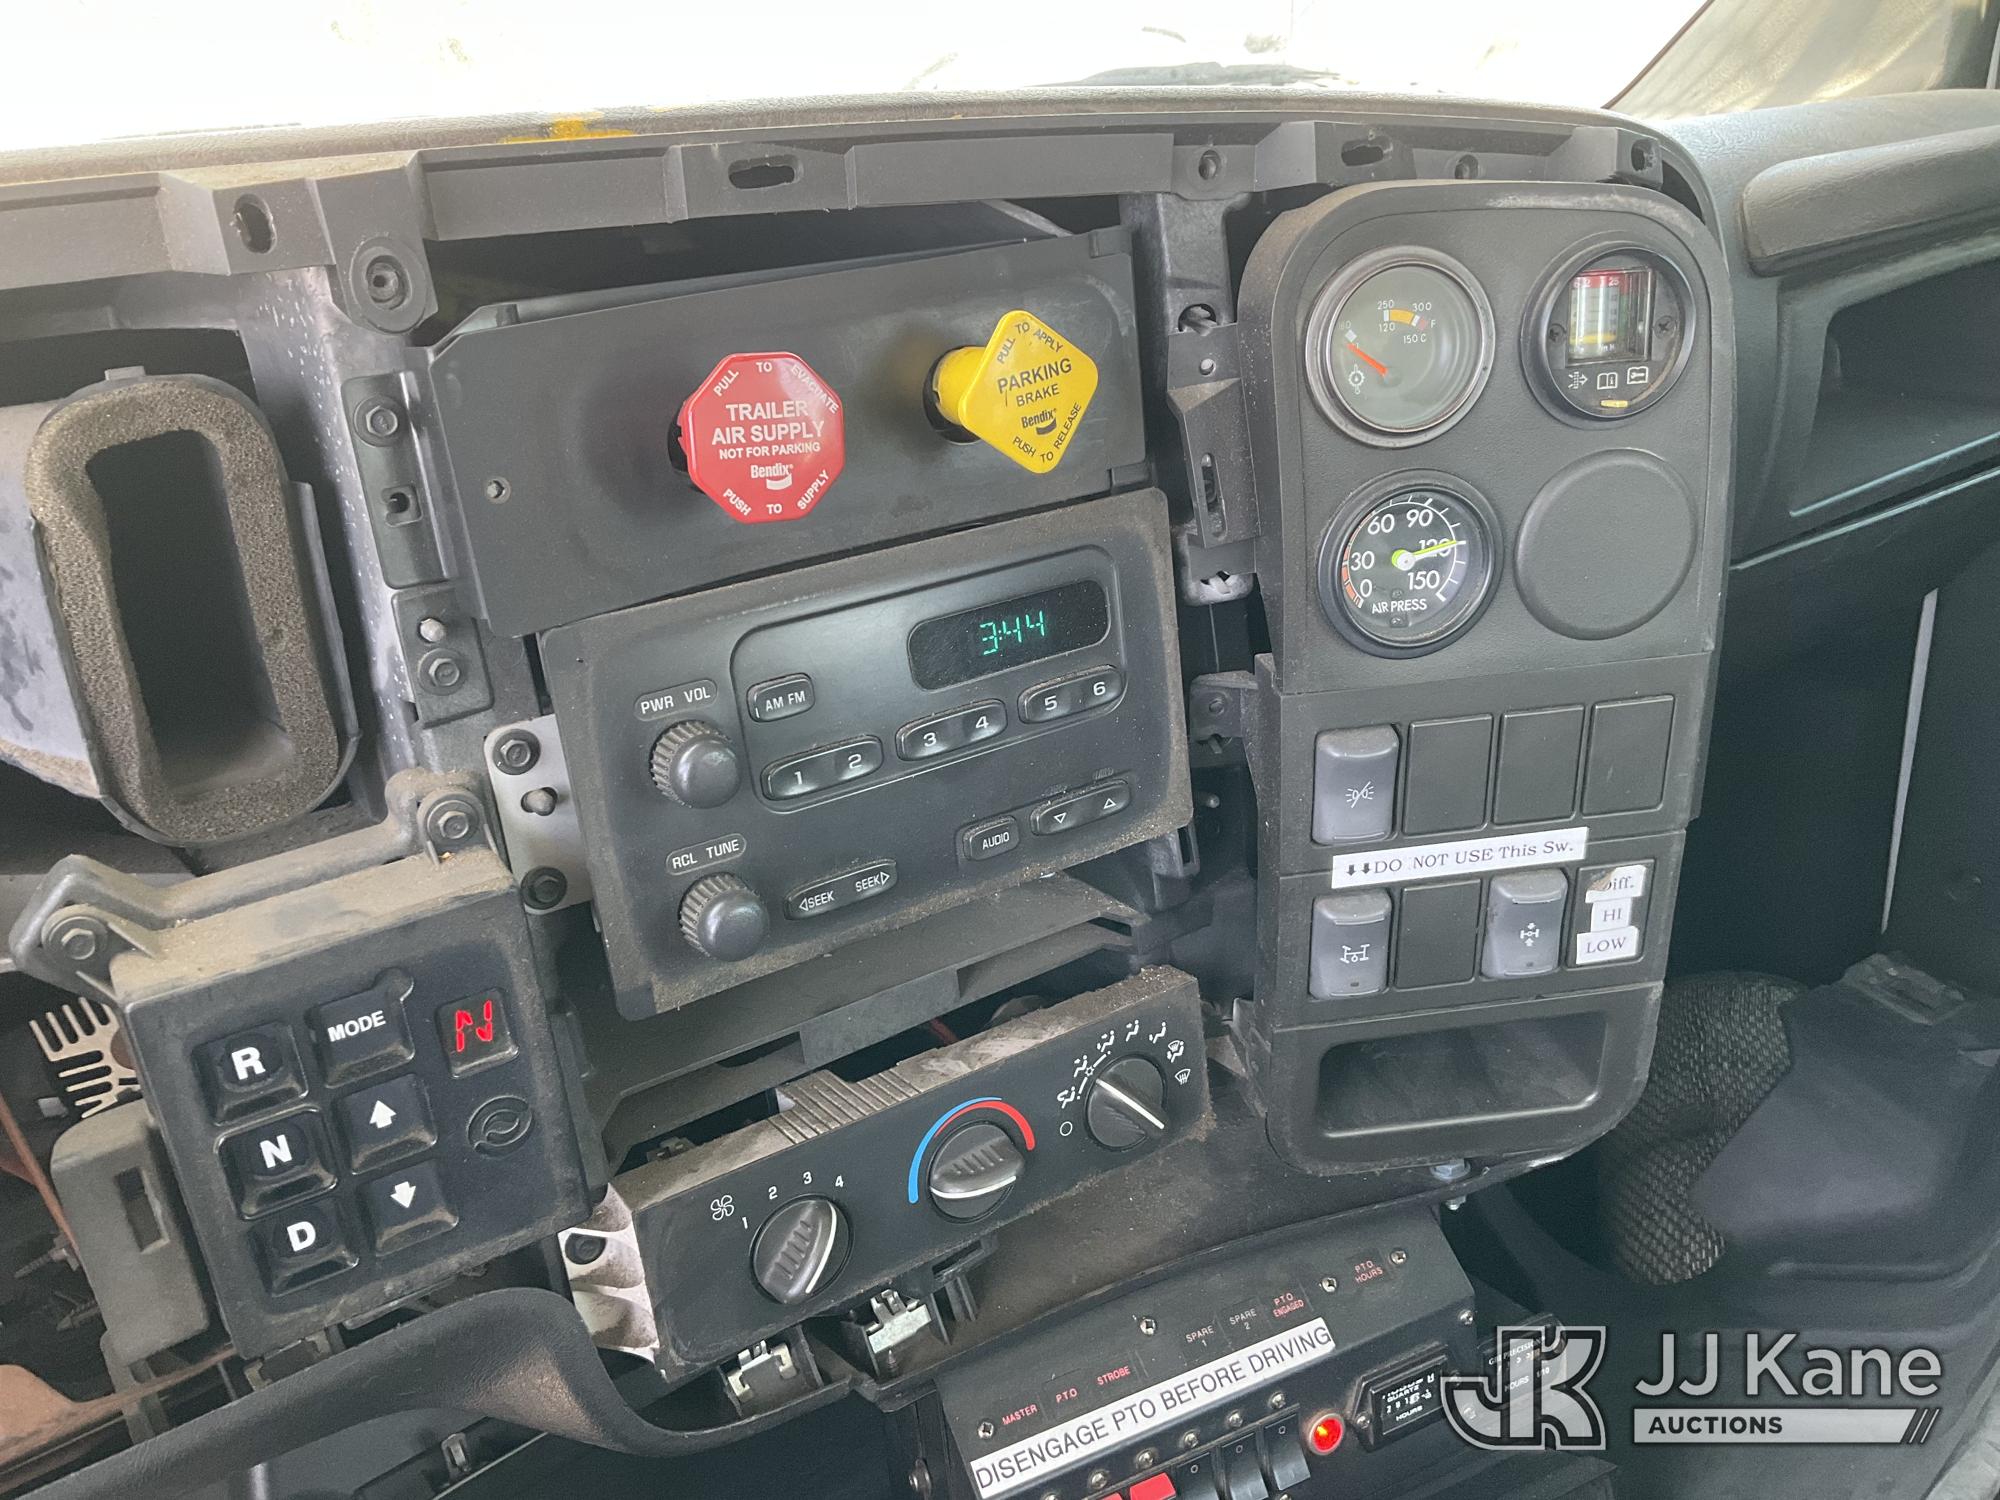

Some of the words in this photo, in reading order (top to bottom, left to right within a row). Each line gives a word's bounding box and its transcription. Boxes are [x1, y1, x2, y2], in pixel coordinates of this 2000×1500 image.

[1377, 299, 1395, 310] 250
[1412, 301, 1432, 312] 300
[1379, 321, 1396, 332] 120
[1430, 319, 1436, 328] F
[996, 337, 1015, 364] PULL
[1014, 321, 1030, 333] TO
[1033, 329, 1063, 354] APPLY
[1403, 334, 1418, 345] 150
[997, 358, 1072, 394] PARKING
[713, 368, 739, 397] PULL
[756, 361, 773, 373] TO
[791, 364, 839, 414] EVACUATE
[1016, 383, 1060, 407] BRAKE
[725, 400, 809, 421] TRAILER
[1021, 409, 1054, 429] Bendix
[711, 426, 746, 445] AIR
[751, 420, 825, 442] SUPPLY
[1012, 436, 1036, 457] PUSH
[1041, 451, 1054, 463] TO
[1053, 402, 1082, 450] RELEASE
[719, 447, 743, 460] NOT
[746, 446, 770, 458] FOR
[772, 442, 821, 455] PARKING
[750, 463, 790, 478] Bendix
[723, 488, 752, 516] PUSH
[766, 503, 782, 514] TO
[797, 469, 829, 510] SUPPLY
[1367, 513, 1395, 535] 60
[1406, 509, 1433, 528] 90
[1350, 551, 1375, 571] 30
[1360, 579, 1373, 598] 0
[1407, 570, 1440, 591] 150
[1371, 602, 1389, 614] AIR
[1390, 599, 1428, 612] PRESS
[979, 609, 1045, 656] 3:44
[1093, 681, 1106, 696] 6
[640, 695, 674, 715] PWR
[683, 686, 711, 703] VOL
[765, 696, 784, 712] AM
[787, 690, 806, 706] FM
[1044, 695, 1058, 711] 5
[975, 715, 989, 730] 4
[922, 731, 937, 748] 3
[848, 753, 862, 769] 2
[793, 771, 802, 785] 1
[982, 831, 1010, 850] AUDIO
[672, 852, 698, 869] RCL
[705, 839, 740, 859] TUNE
[1374, 859, 1403, 875] DO
[1412, 854, 1449, 869] NOT
[1455, 848, 1494, 865] USE
[1499, 842, 1537, 859] This
[1543, 840, 1574, 856] Sw.
[855, 875, 881, 893] SEEK
[808, 890, 836, 910] SEEK
[1602, 908, 1622, 922] HI
[1586, 936, 1627, 954] LOW
[327, 1010, 386, 1042] MODE
[231, 1046, 267, 1080] R
[259, 1134, 293, 1169] N
[803, 1171, 813, 1185] 3
[835, 1175, 844, 1188] 4
[768, 1185, 778, 1200] 2
[742, 1216, 748, 1229] 1
[286, 1221, 317, 1252] D
[1354, 1267, 1383, 1283] HOURS
[1229, 1308, 1258, 1326] SPARE
[1244, 1322, 1251, 1330] 2
[1185, 1325, 1214, 1343] SPARE
[1201, 1339, 1207, 1347] 1
[1097, 1365, 1131, 1386] STROBE
[975, 1418, 1109, 1489] DISENGAGE
[1112, 1398, 1156, 1431] PTO
[1160, 1360, 1247, 1411] BEFORE
[1247, 1326, 1332, 1374] DRIVING
[1002, 1404, 1038, 1425] MASTER
